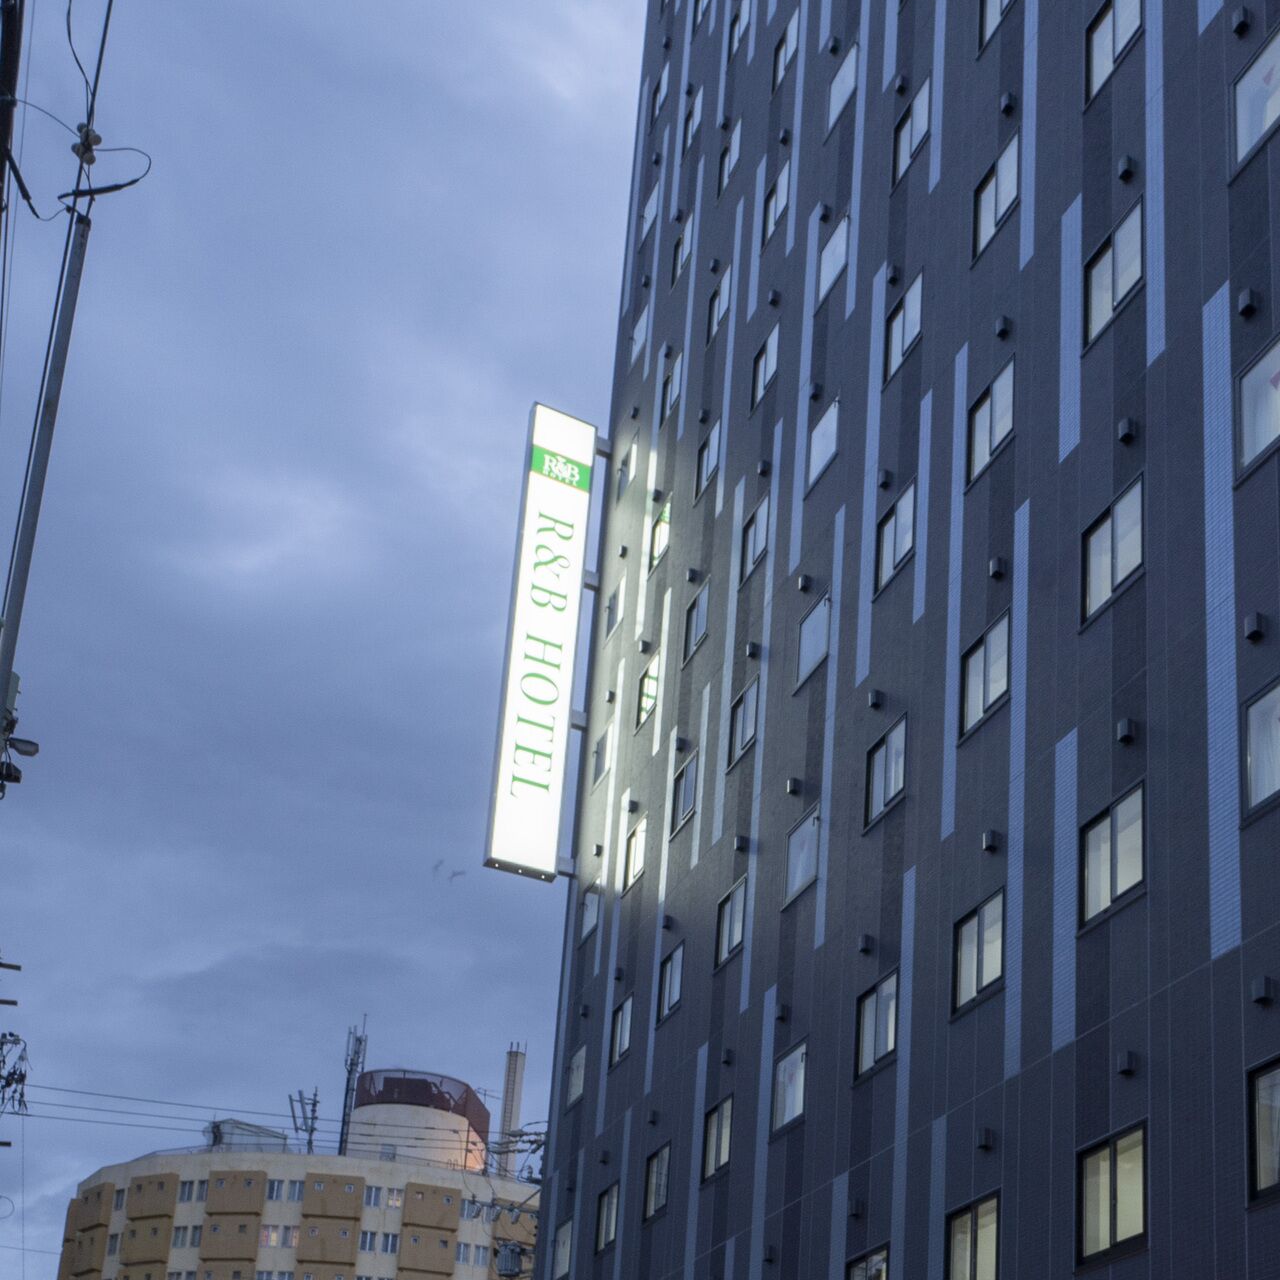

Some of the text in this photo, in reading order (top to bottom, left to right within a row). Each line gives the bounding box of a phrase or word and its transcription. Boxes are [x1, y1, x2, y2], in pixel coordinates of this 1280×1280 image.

[543, 454, 580, 481] R&B
[510, 512, 574, 799] R&B HOTEL
